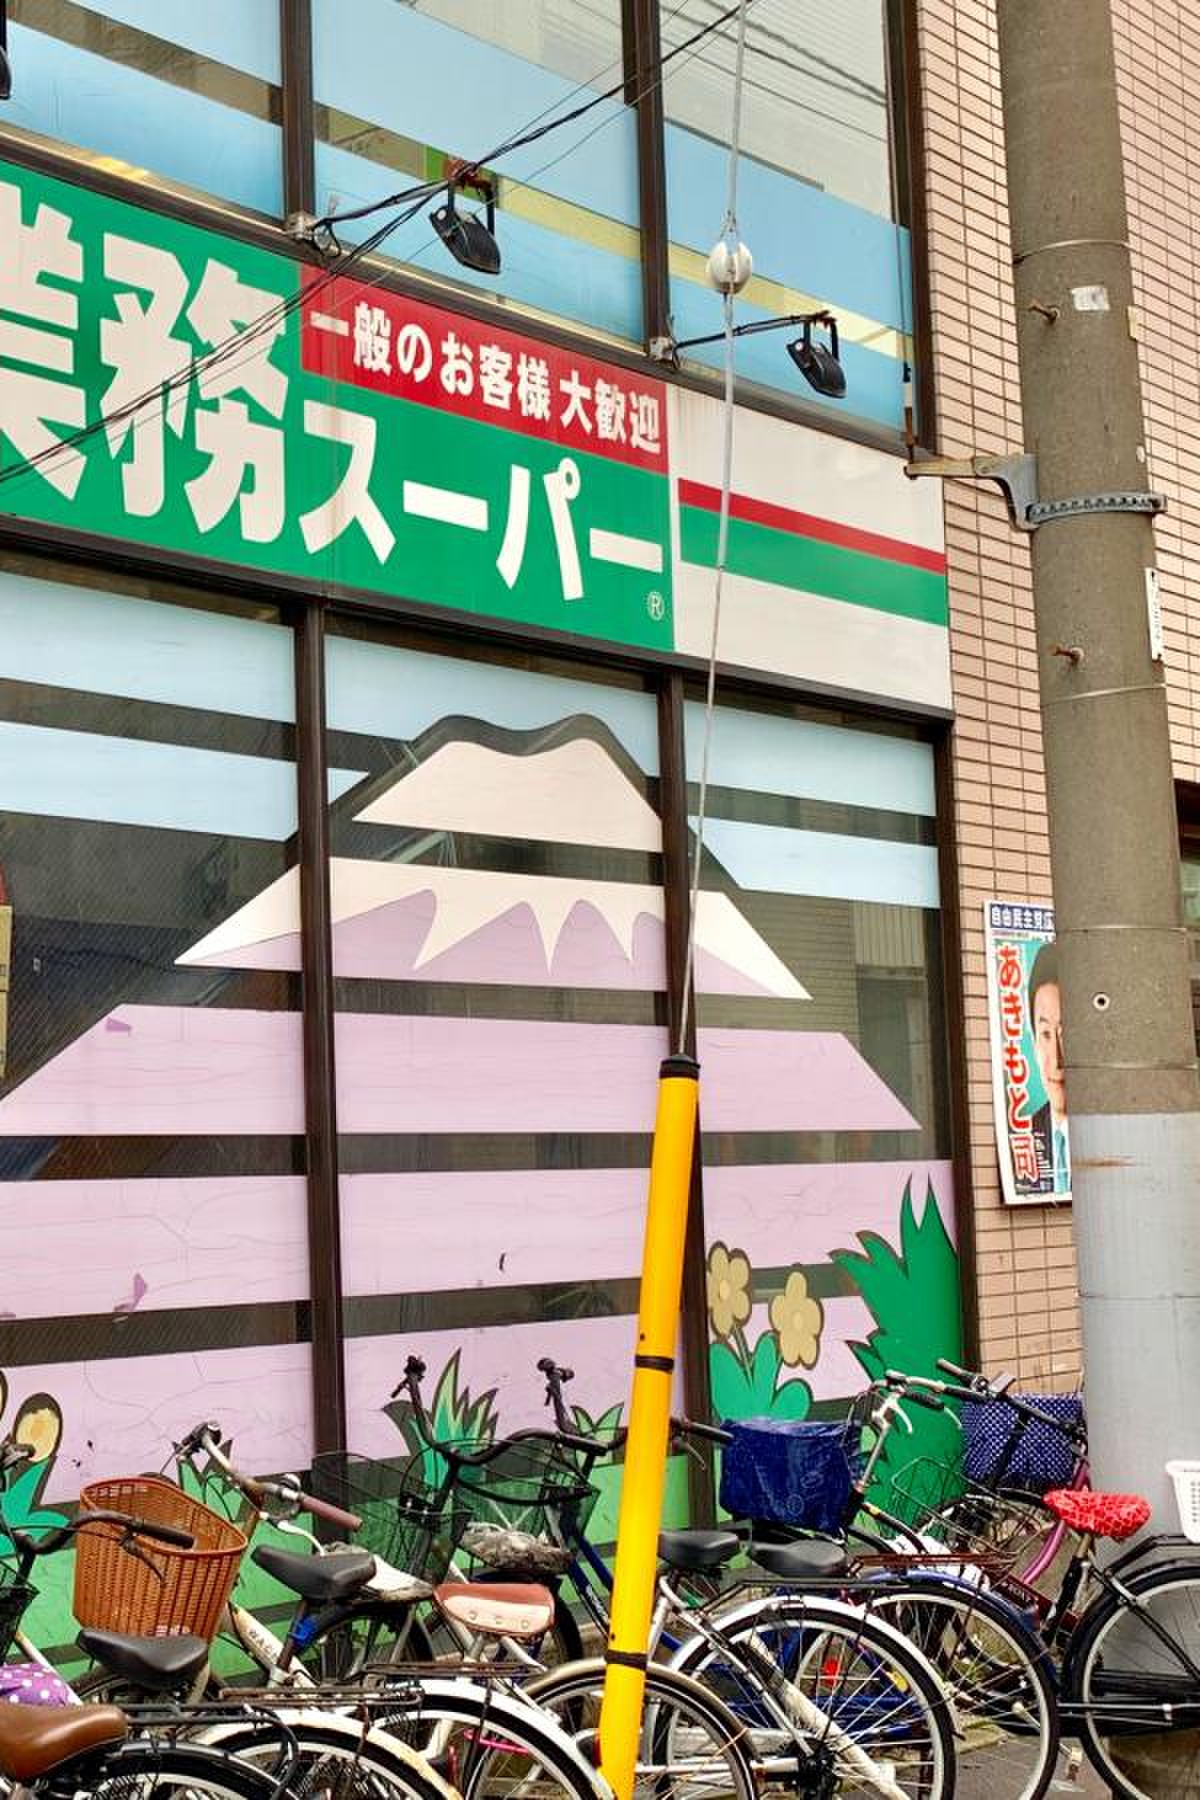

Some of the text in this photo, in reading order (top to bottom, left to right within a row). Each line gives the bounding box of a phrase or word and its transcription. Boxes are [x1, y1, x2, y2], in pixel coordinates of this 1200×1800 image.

[310, 301, 661, 455] 一般のお客様 大歓迎
